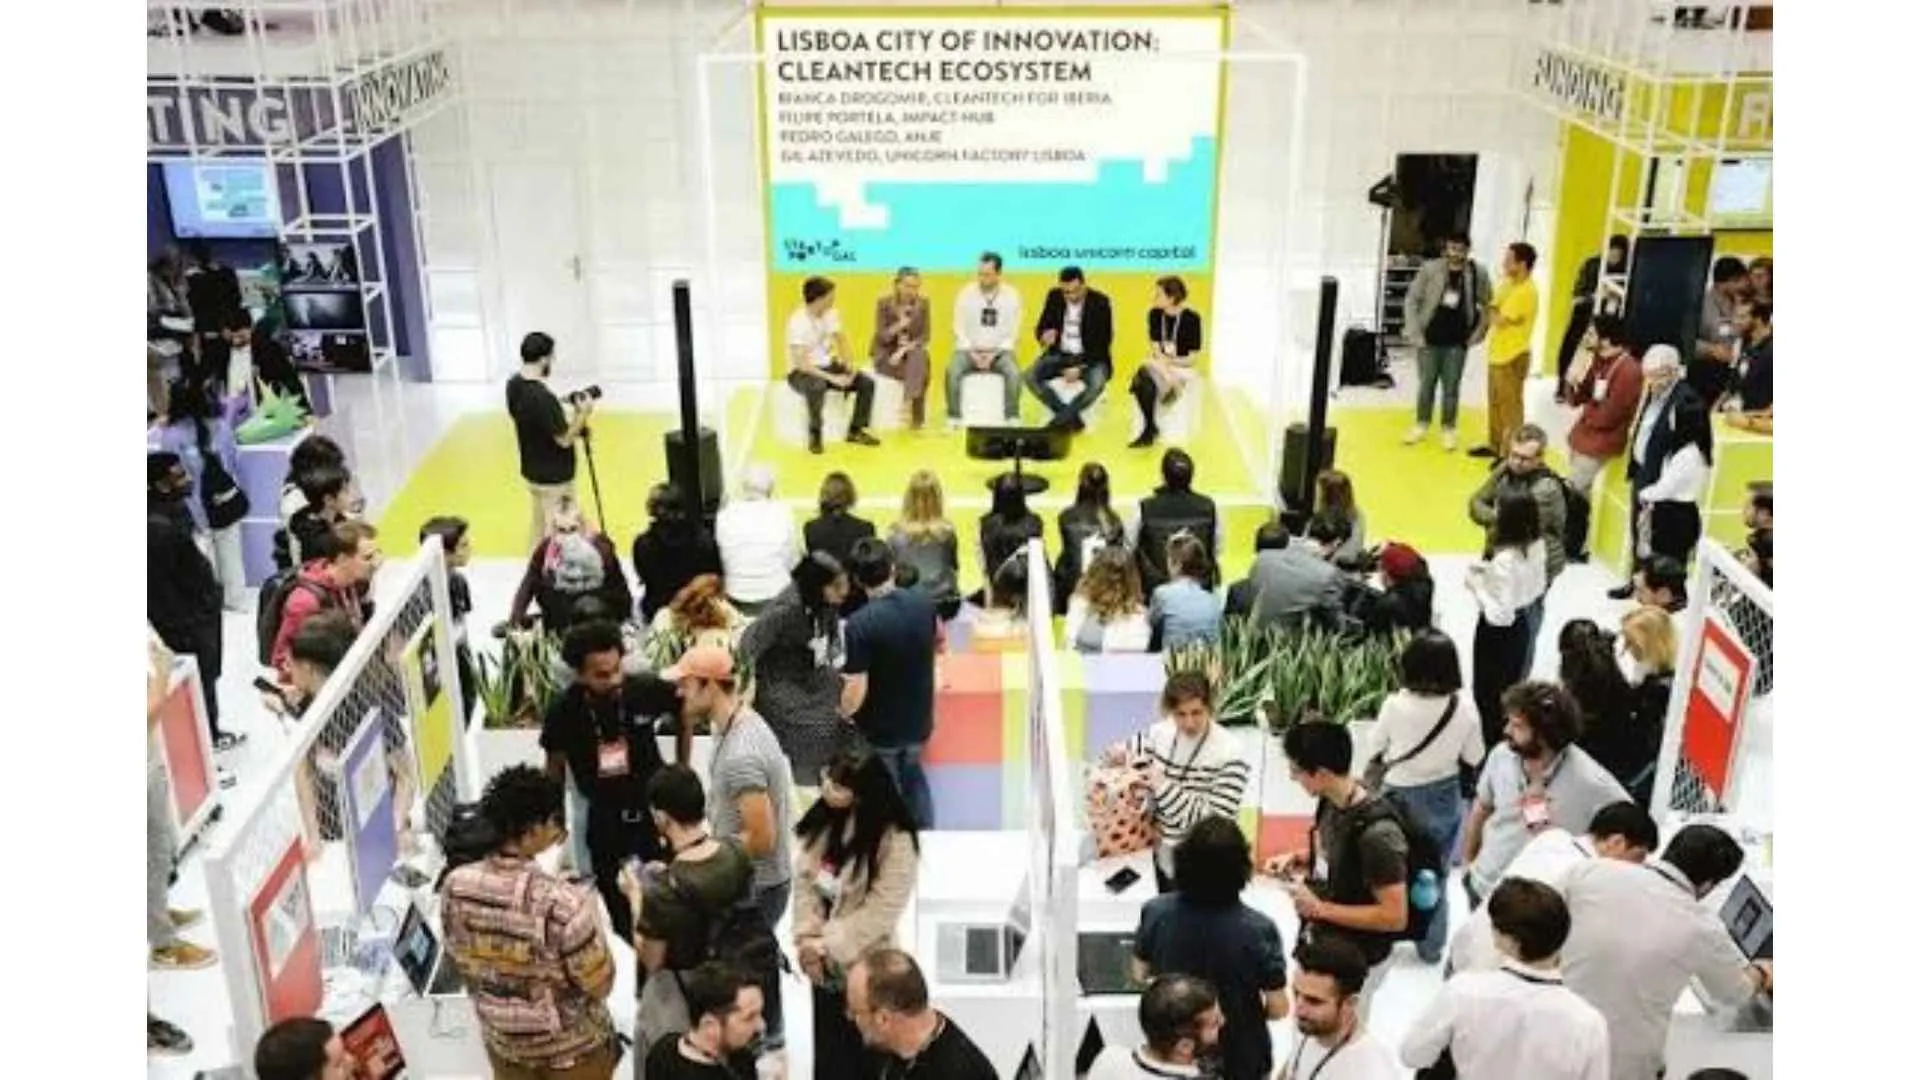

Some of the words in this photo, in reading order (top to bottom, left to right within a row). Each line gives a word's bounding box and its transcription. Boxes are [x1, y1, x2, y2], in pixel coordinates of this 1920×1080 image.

[778, 30, 870, 52] LISBOA
[876, 30, 935, 52] CITY
[941, 30, 977, 52] OF
[983, 30, 1160, 53] INNOVATION:
[778, 60, 932, 83] CLEANTECH
[939, 61, 1092, 83] ECOSYSTEM
[778, 91, 837, 105] BIANCA
[932, 91, 1025, 105] CLEANTECH
[1027, 91, 1059, 105] FOR
[1063, 91, 1113, 105] IBERIA
[902, 111, 958, 124] IMPACT
[961, 111, 995, 124] HUB
[780, 130, 833, 143] PEDRO
[962, 149, 1031, 163] FACTORY
[1033, 149, 1086, 163] LISBOA
[1019, 245, 1071, 259] lisboa
